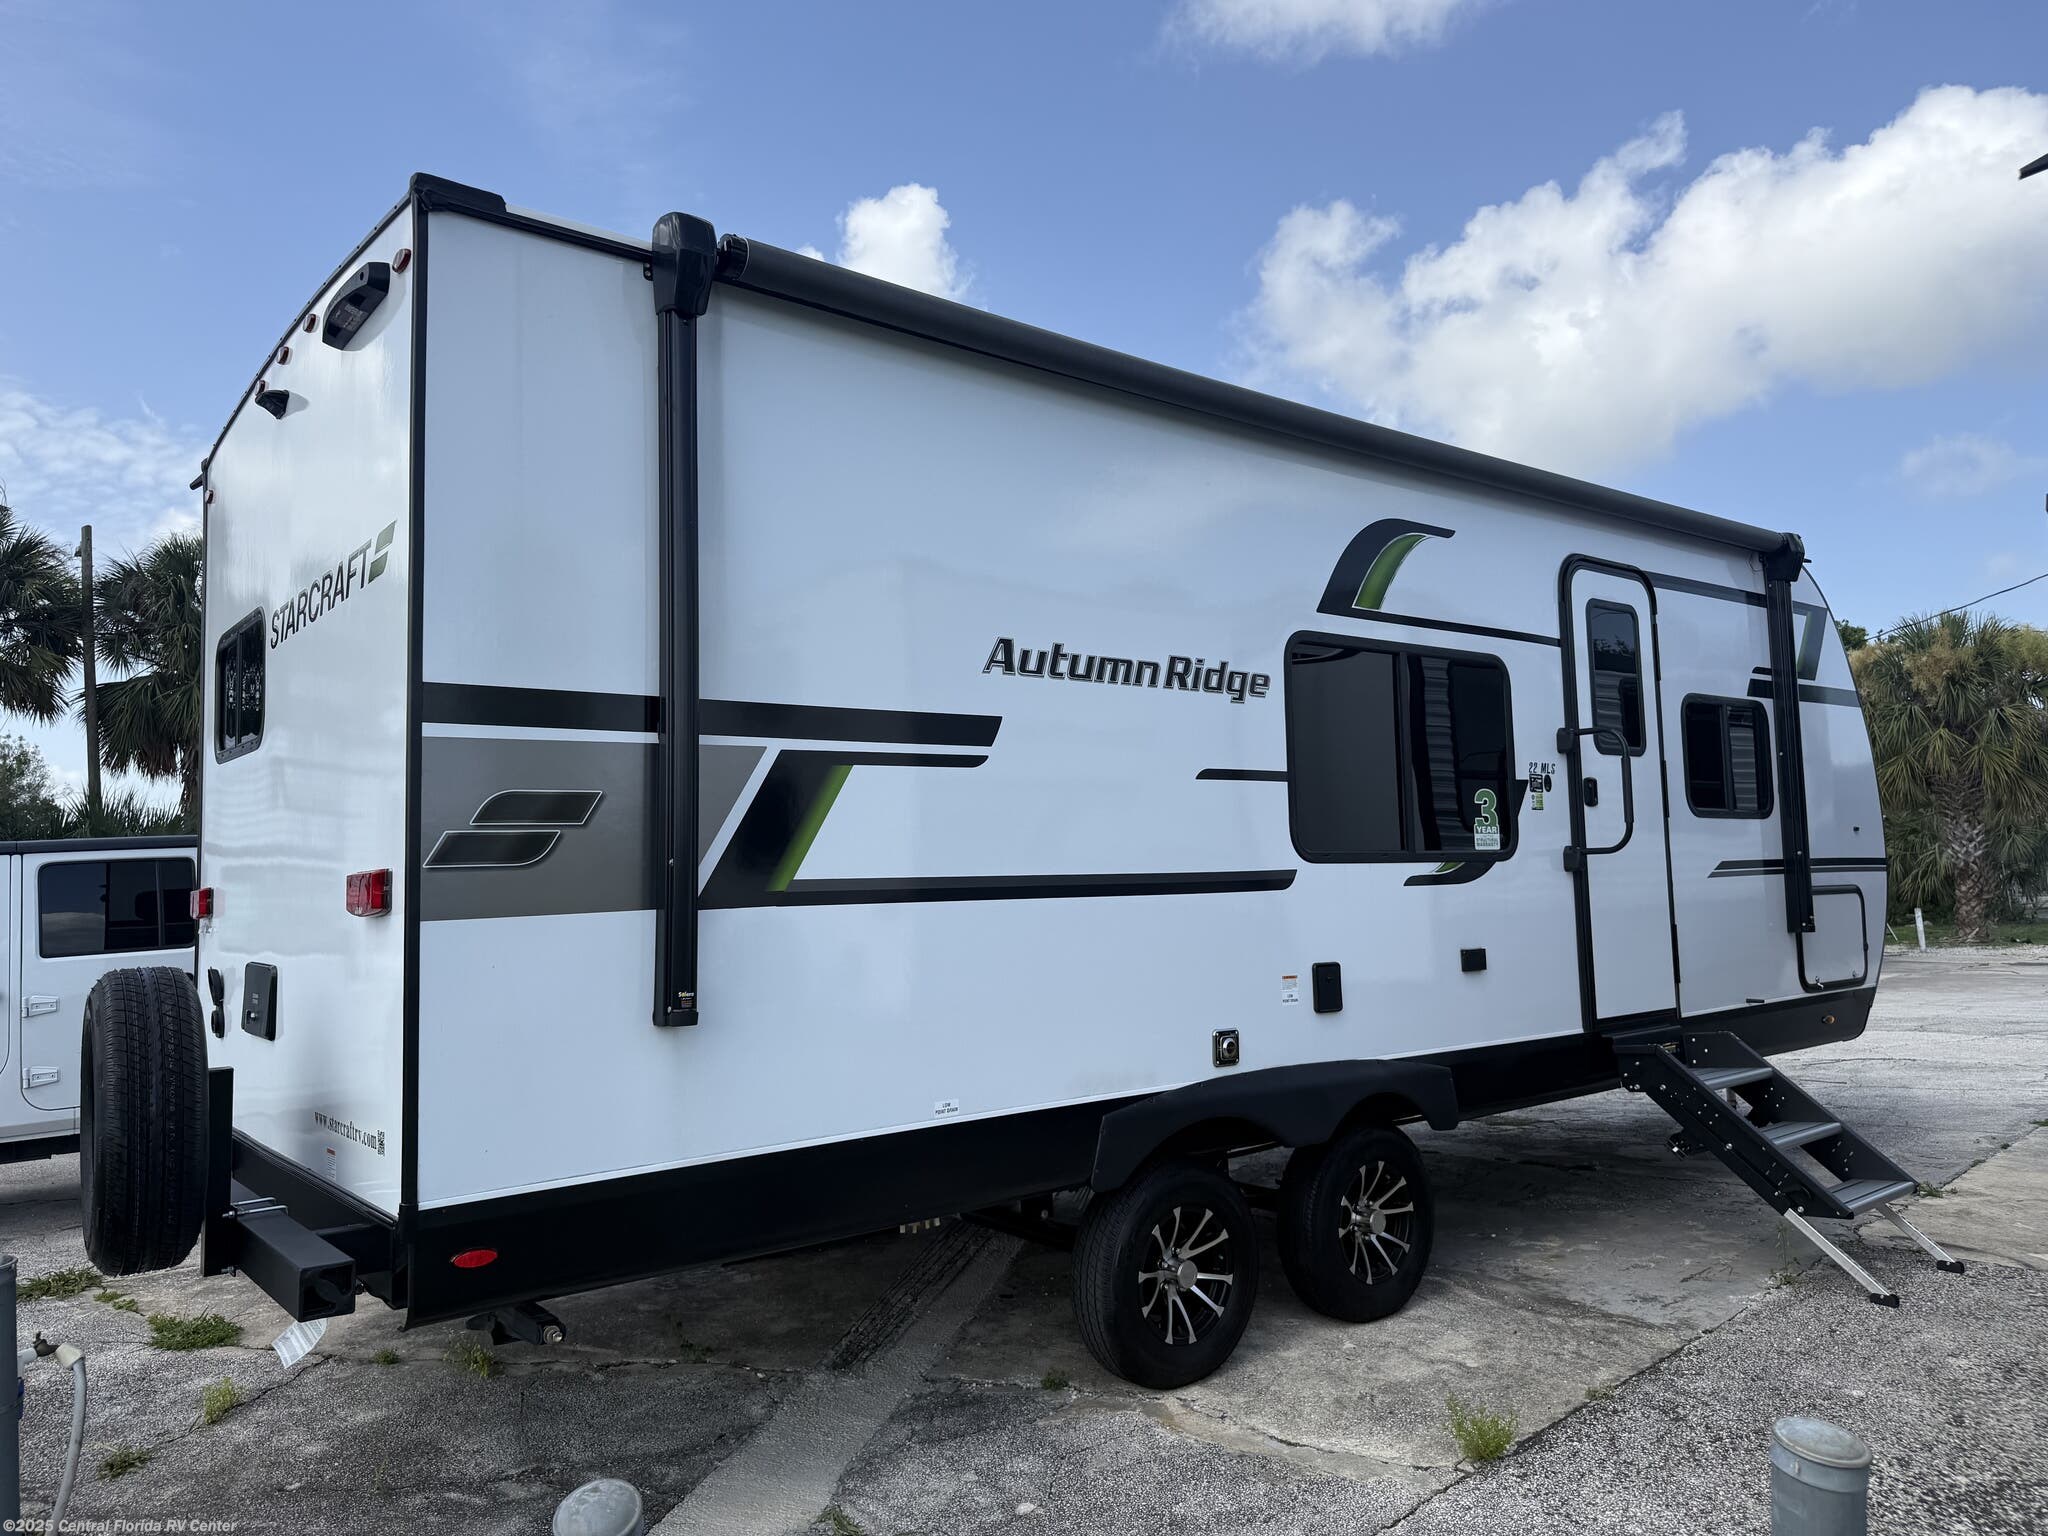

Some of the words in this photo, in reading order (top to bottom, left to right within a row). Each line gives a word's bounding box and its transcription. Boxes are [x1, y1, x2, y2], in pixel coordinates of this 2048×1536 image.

[270, 538, 372, 650] STARCRAFT
[982, 636, 1161, 688] Autumn
[1163, 655, 1271, 704] Ridge
[1474, 788, 1499, 826] 3
[1476, 826, 1498, 834] YEAR
[314, 1111, 377, 1150] www.starcraftrv.com
